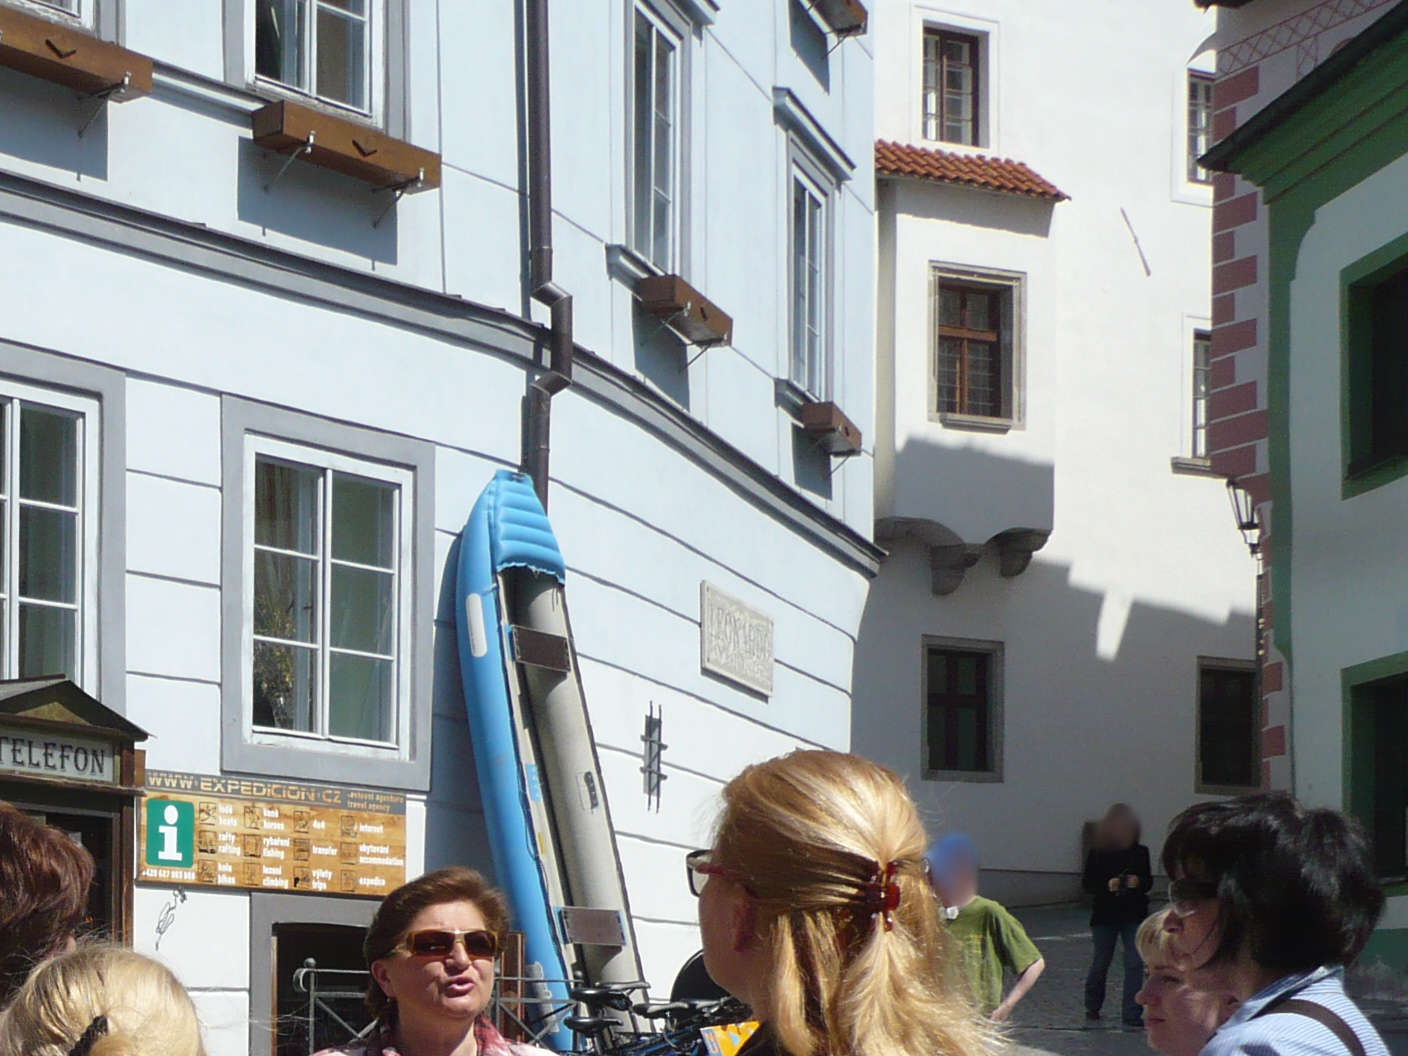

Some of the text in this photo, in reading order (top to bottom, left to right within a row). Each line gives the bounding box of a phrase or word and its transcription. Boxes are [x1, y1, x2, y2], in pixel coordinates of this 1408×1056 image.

[219, 816, 237, 826] boats
[263, 820, 285, 830] horses
[359, 823, 383, 834] internet
[218, 832, 236, 843] rafty
[218, 844, 241, 856] rafting
[263, 848, 285, 860] fishing
[312, 845, 338, 855] transfer
[263, 876, 289, 889] climbing
